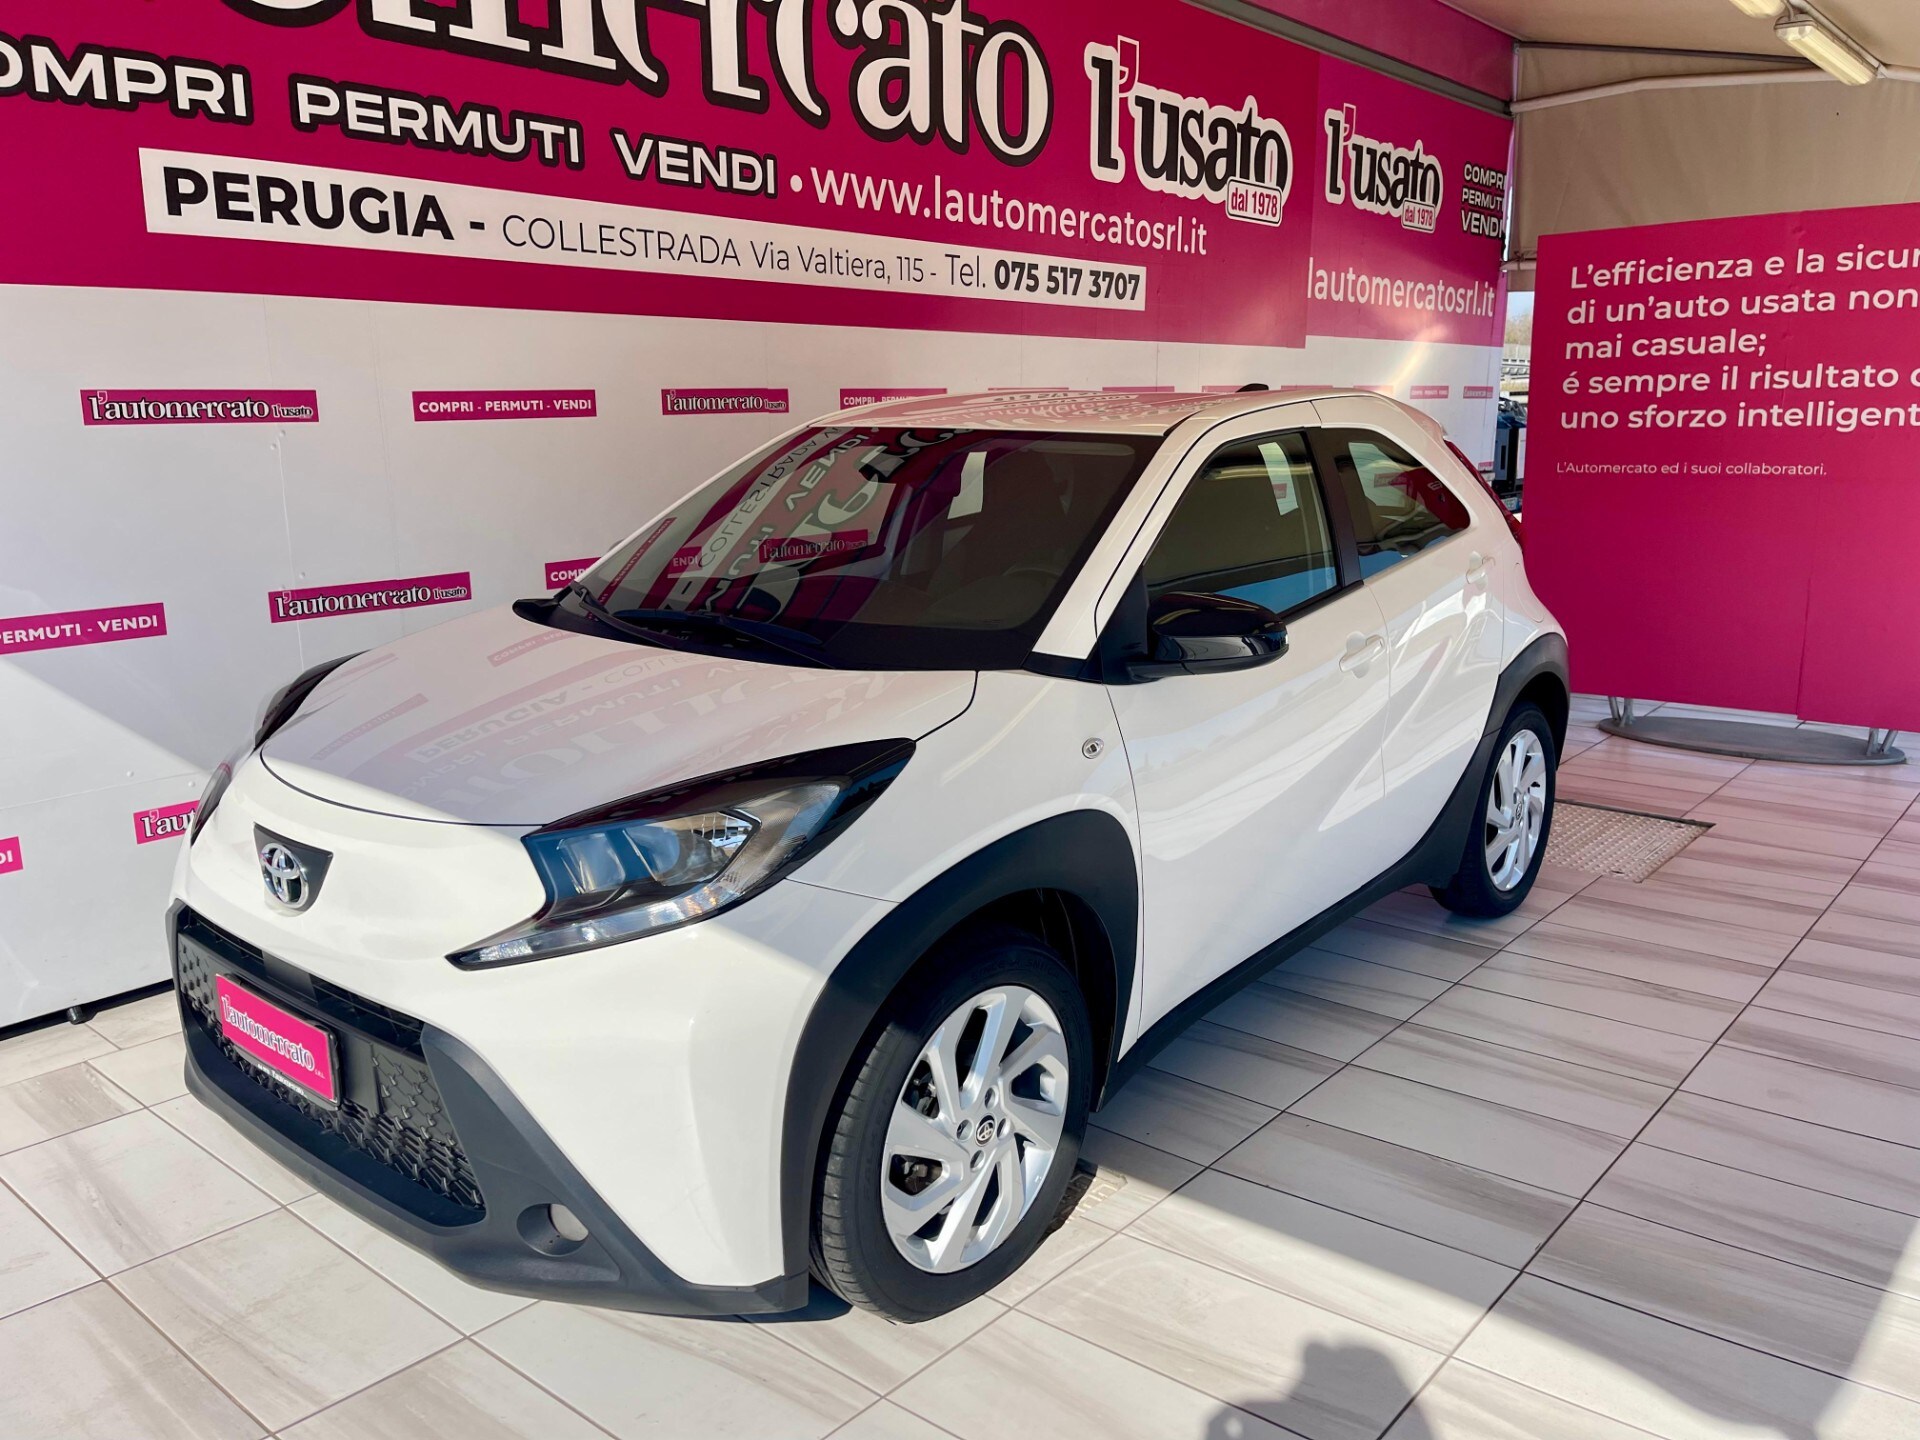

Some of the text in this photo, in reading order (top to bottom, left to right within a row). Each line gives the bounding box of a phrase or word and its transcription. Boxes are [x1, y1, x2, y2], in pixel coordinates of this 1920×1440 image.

[1088, 35, 1289, 193] l'usato
[296, 82, 580, 163] PERMUTI
[613, 132, 776, 195] VENDI
[810, 166, 1207, 256] www.lautomercatosrl.it
[1328, 102, 1441, 210] l'usato
[1231, 187, 1278, 218] dal 1978
[1404, 205, 1433, 227] dal 1978
[162, 166, 455, 241] PERUGIA
[502, 213, 741, 267] COLLESTRADA
[750, 240, 790, 272] Via
[797, 245, 891, 284] Valtiera,
[896, 255, 924, 283] 115
[944, 252, 986, 289] Tel.
[994, 258, 1039, 292] 075
[1046, 264, 1083, 296] 517
[1088, 269, 1141, 301] 3707
[1571, 256, 1753, 289] L'efficienza
[1764, 255, 1785, 276] e
[1796, 248, 1825, 274] la
[1307, 256, 1495, 318] lautomercatosrl.it
[1567, 287, 1919, 325] di un'auto usata non
[1565, 328, 1767, 360] mai casuale;
[1588, 371, 1711, 398] sempre
[1721, 365, 1739, 390] il
[1749, 363, 1899, 390] risultato
[88, 390, 269, 420] l'automercato
[419, 401, 474, 413] COMPRI
[485, 400, 544, 412] PERMUTI
[553, 399, 592, 410] VENDI
[665, 389, 762, 411] l'automercato
[1560, 400, 1920, 433] uno sforzo intelligent
[1556, 461, 1827, 476] L'Automercato ed i suoi collaboratori.
[0, 622, 82, 645] ERMUTI
[97, 614, 158, 633] VENDI
